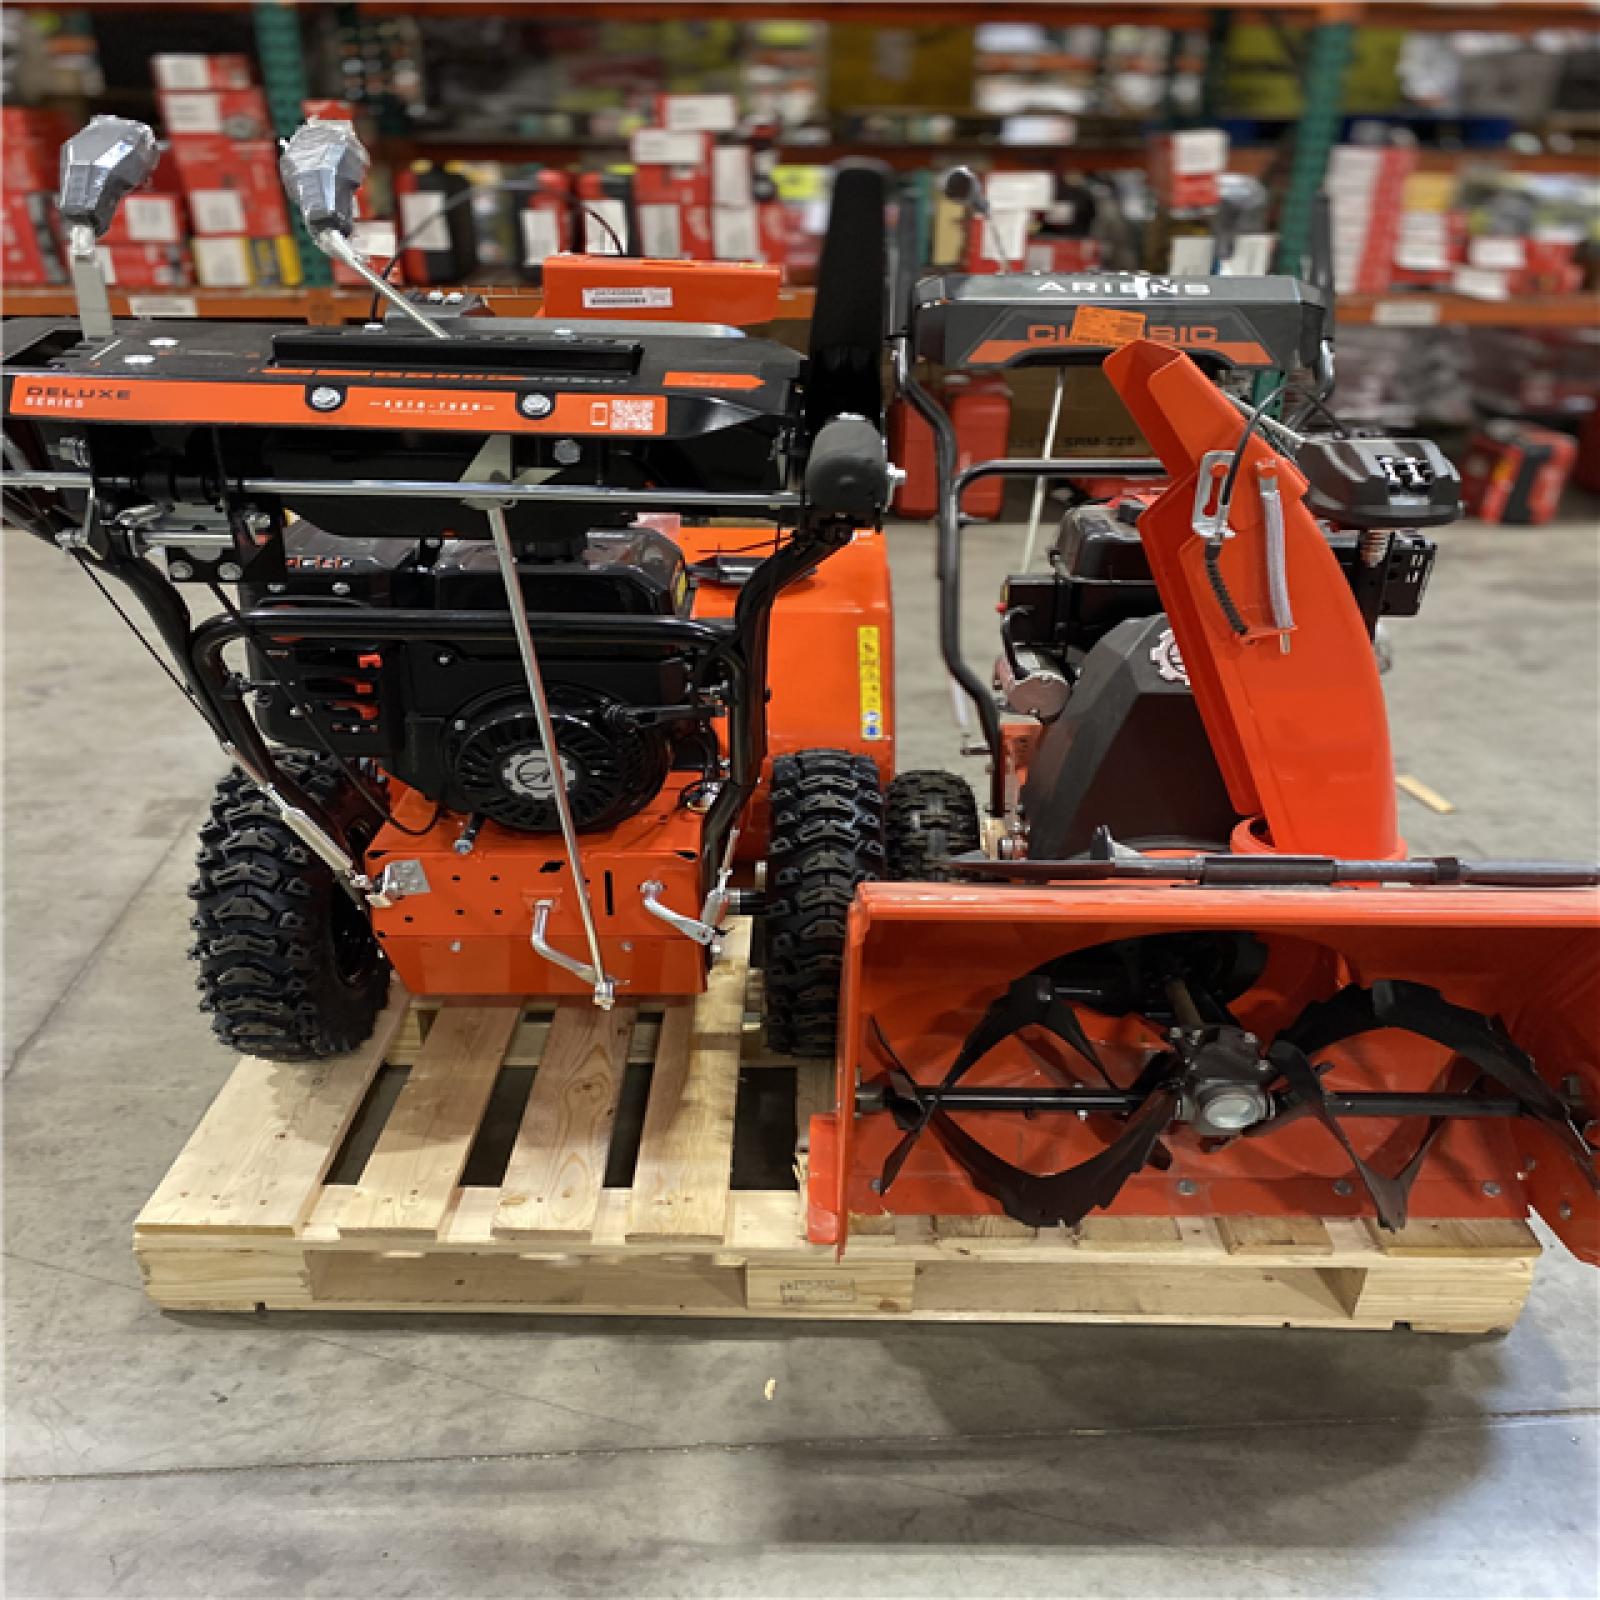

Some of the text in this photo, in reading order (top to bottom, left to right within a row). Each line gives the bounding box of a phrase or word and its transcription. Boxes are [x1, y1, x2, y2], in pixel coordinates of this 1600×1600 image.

[1037, 279, 1211, 297] ARIENS
[1027, 324, 1219, 343] CLSIC
[26, 387, 131, 400] DELUXE
[24, 396, 84, 408] SERIES
